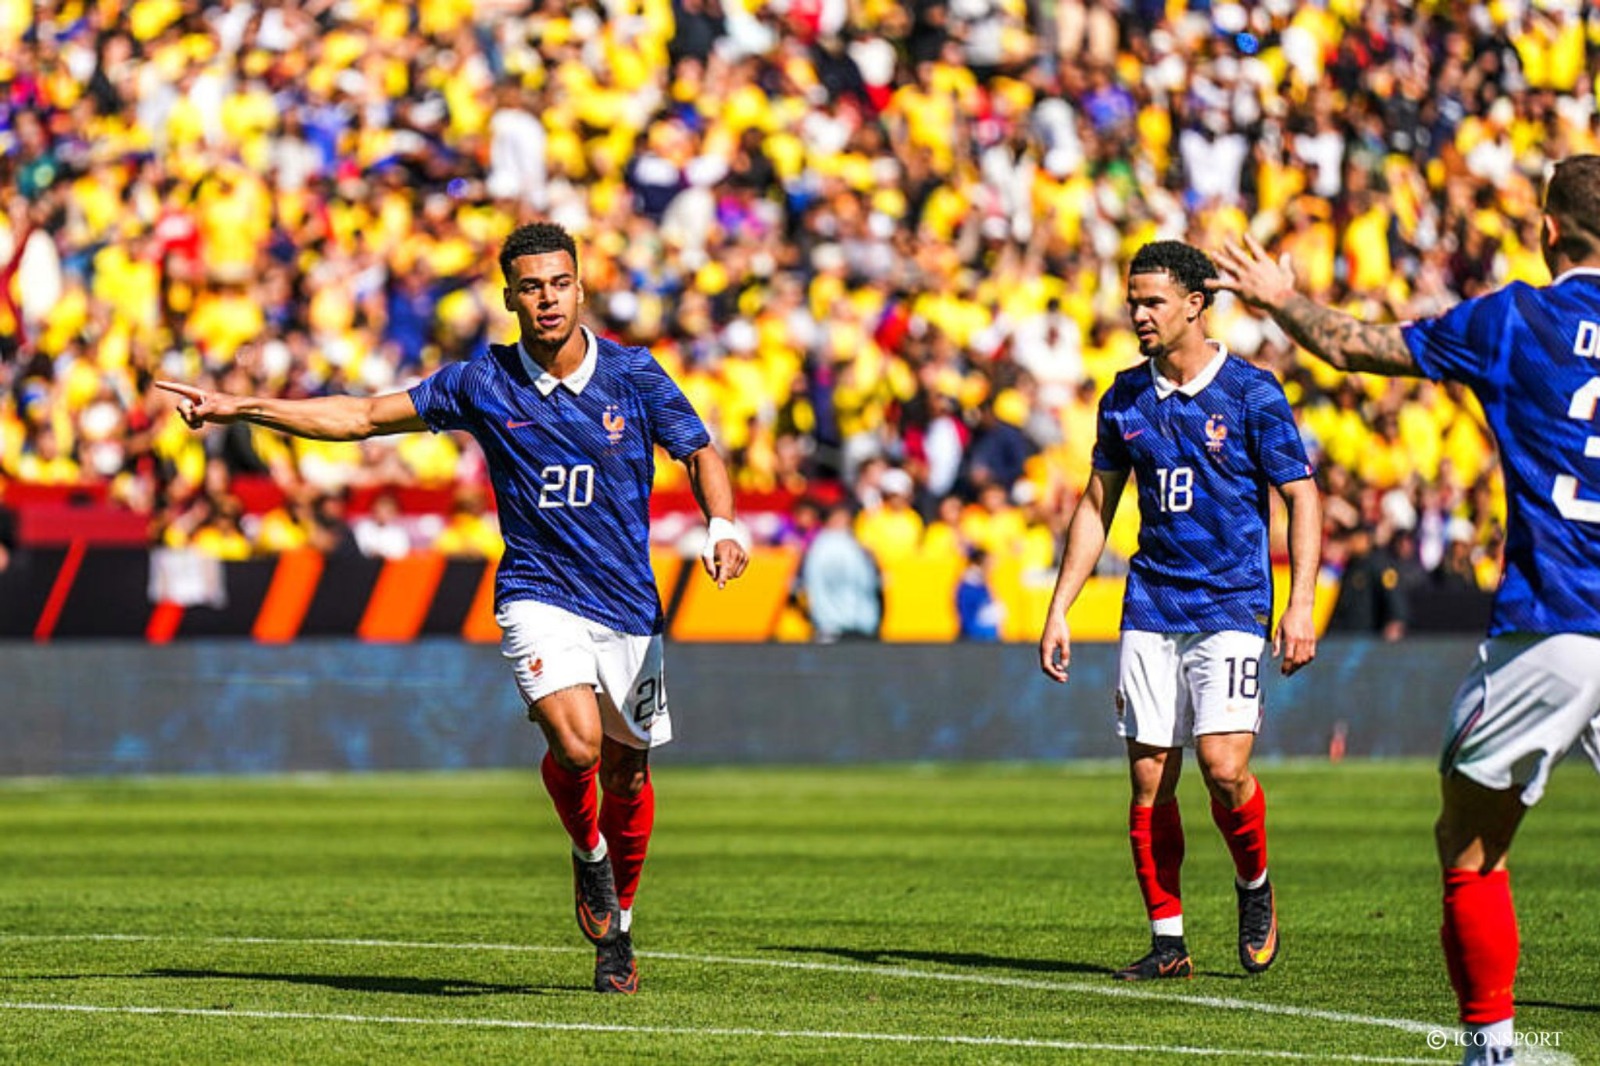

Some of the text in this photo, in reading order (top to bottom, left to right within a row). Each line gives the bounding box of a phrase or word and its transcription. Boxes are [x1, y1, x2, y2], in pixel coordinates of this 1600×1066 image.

[1573, 320, 1600, 358] D
[538, 464, 594, 508] 20
[1156, 466, 1193, 512] 18
[1225, 657, 1259, 698] 18
